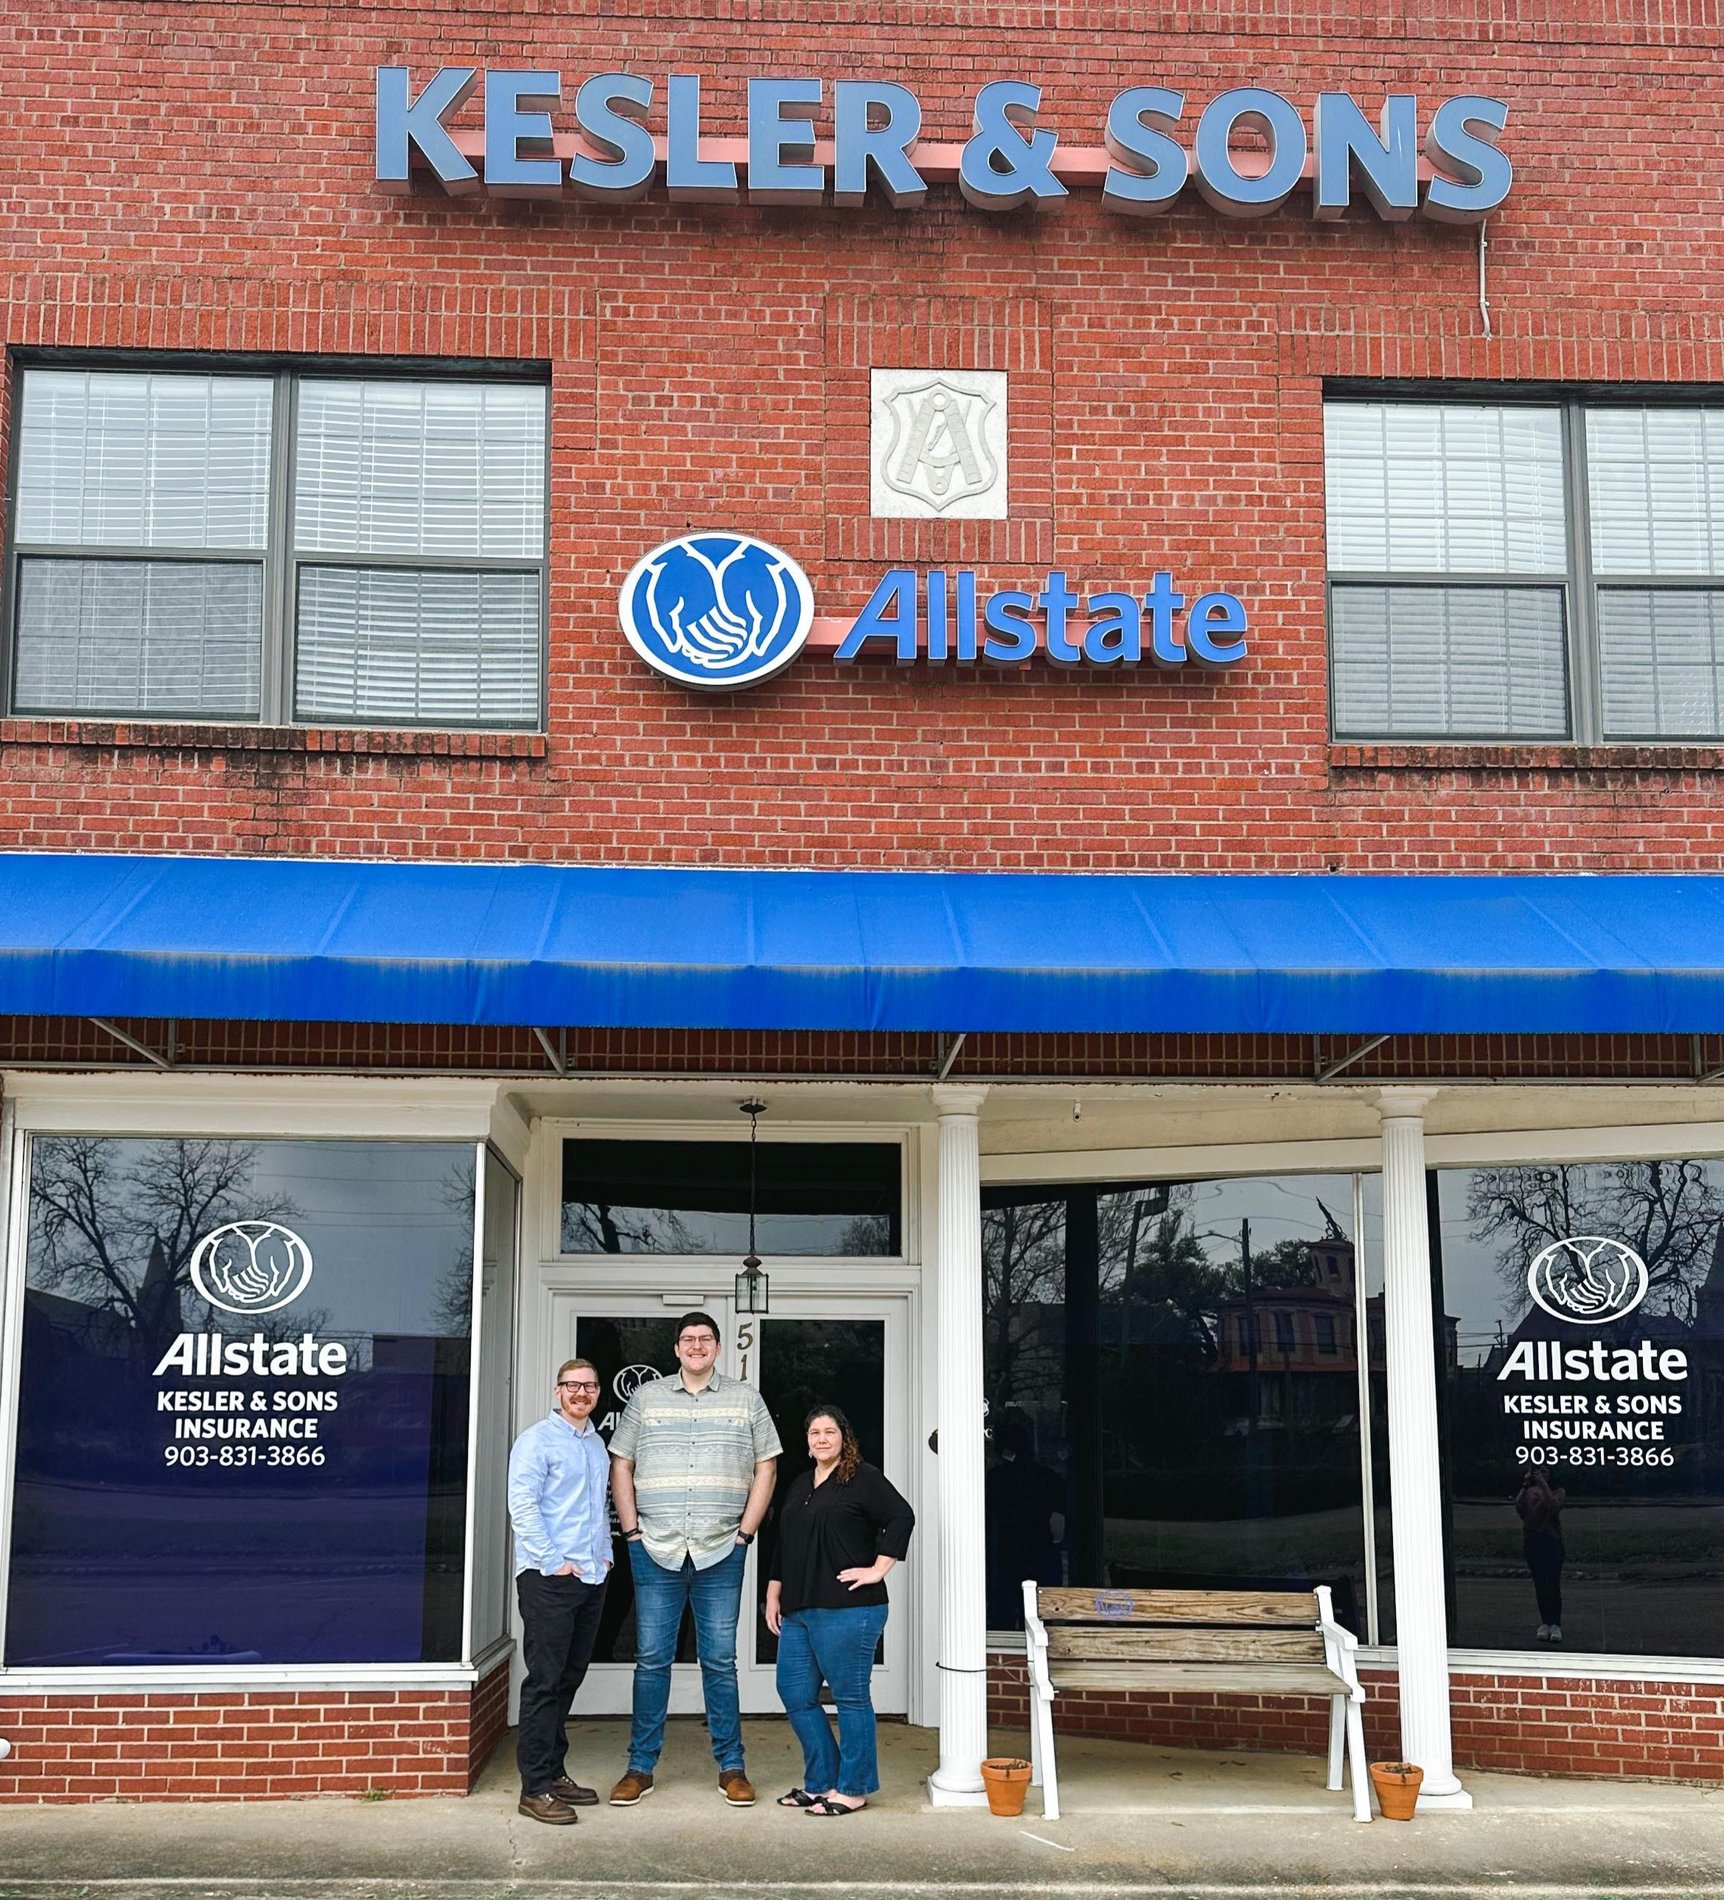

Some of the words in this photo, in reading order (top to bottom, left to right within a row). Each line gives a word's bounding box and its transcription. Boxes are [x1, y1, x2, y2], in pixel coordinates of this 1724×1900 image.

[375, 65, 928, 193] KESLER
[959, 80, 1070, 198] &
[1103, 85, 1513, 210] SONS
[833, 569, 1248, 664] Allstate
[152, 1333, 347, 1376] Allstate
[1496, 1340, 1688, 1381] Allstate
[157, 1391, 245, 1412] KESLER
[250, 1391, 268, 1412] &
[272, 1391, 338, 1412] SONS
[1504, 1395, 1589, 1414] KESLER
[1594, 1395, 1612, 1414] &
[1616, 1395, 1682, 1414] SONS
[175, 1418, 318, 1439] INSURANCE
[1522, 1420, 1664, 1440] INSURANCE
[164, 1445, 325, 1467] 903-831-3866
[1515, 1446, 1674, 1467] 903-831-3866
